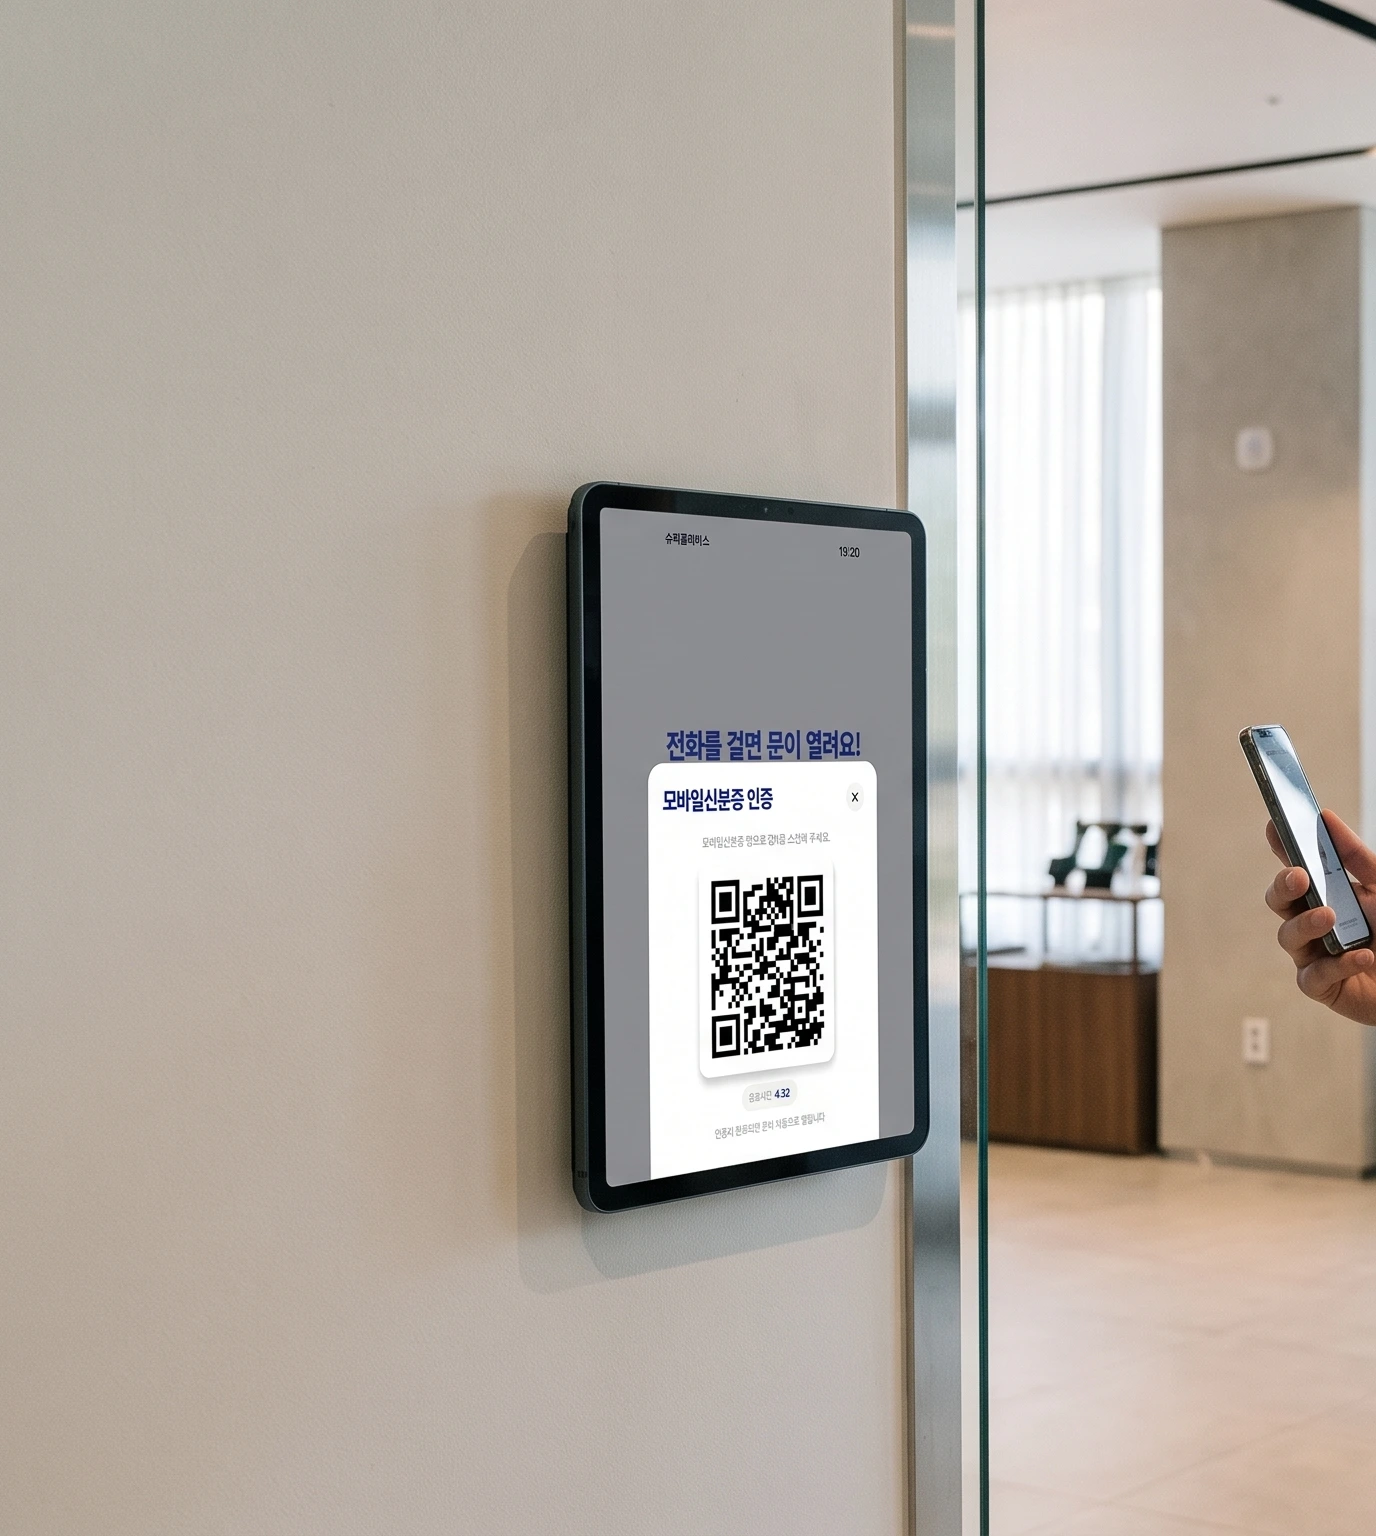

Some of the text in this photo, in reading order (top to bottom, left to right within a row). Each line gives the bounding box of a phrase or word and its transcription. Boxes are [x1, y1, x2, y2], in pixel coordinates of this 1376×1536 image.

[666, 730, 861, 761] 전화를 걸면 문이 열려요!
[663, 787, 774, 812] 모바일신분증 인증
